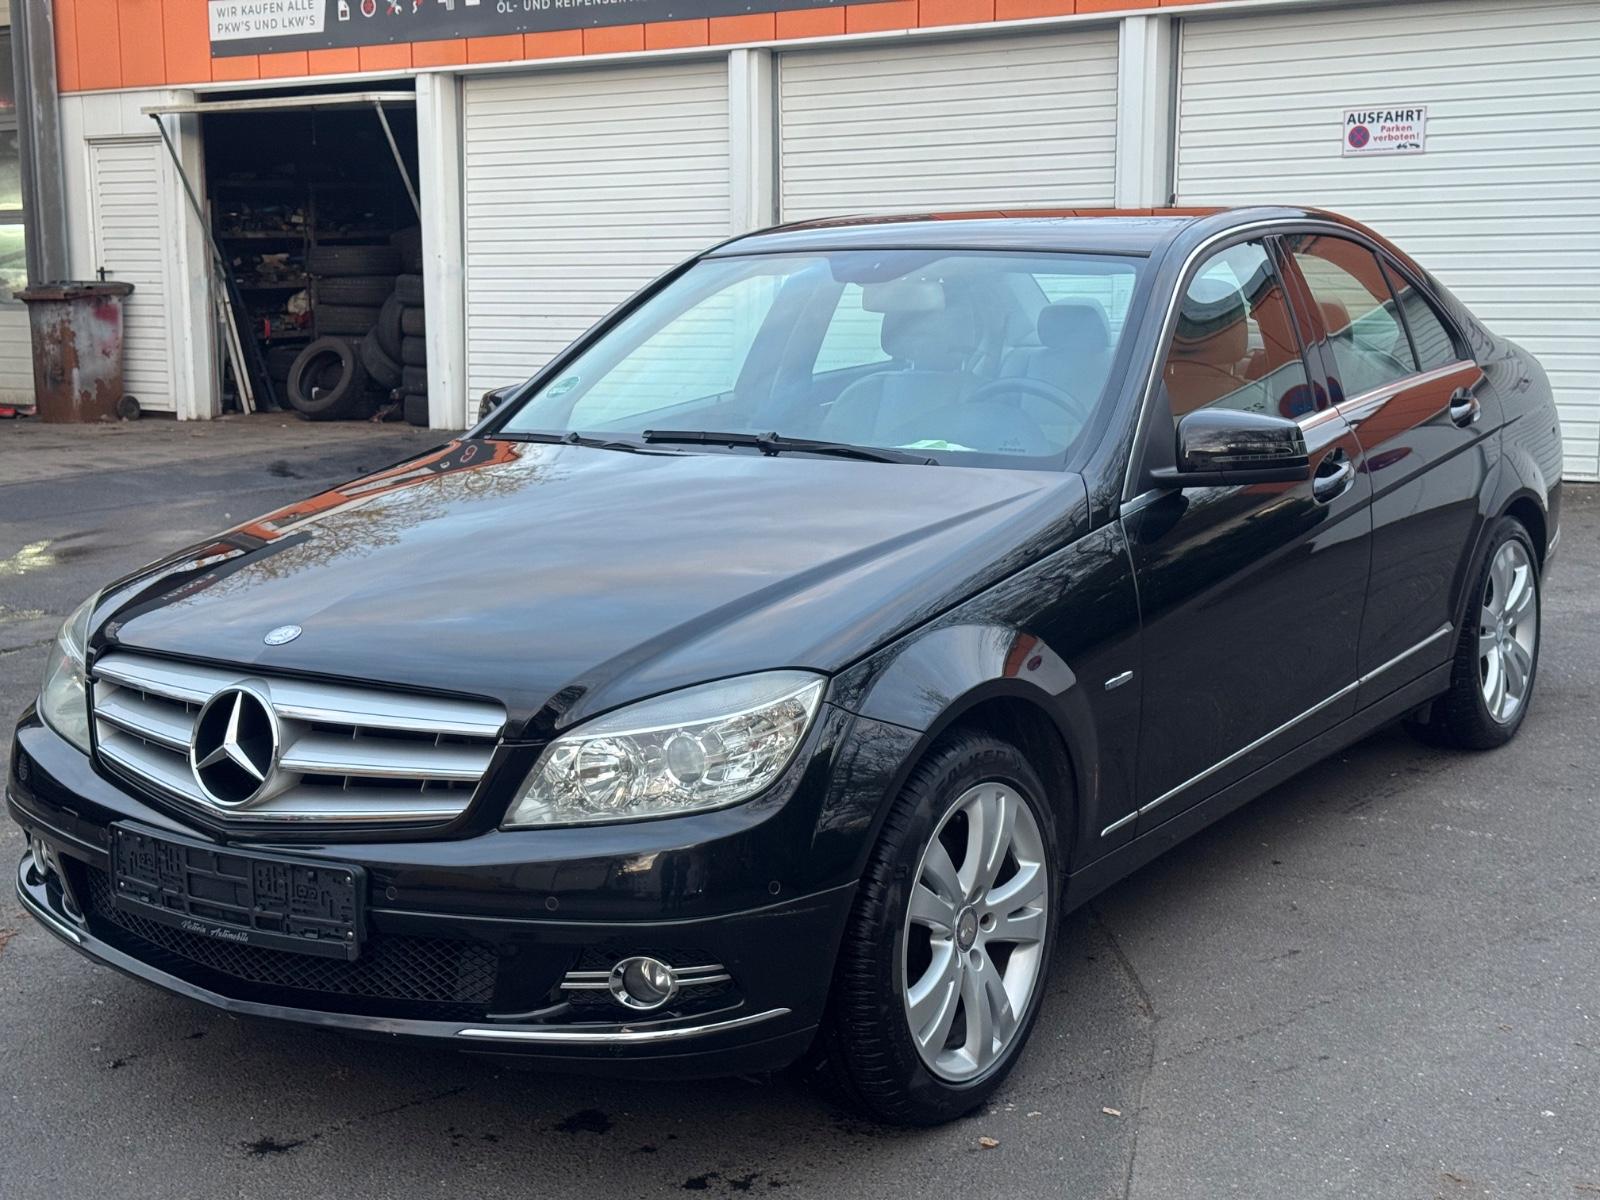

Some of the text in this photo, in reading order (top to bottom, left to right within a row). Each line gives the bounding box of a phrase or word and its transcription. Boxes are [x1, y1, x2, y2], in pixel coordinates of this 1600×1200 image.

[216, 0, 315, 18] WIR KAUFEN ALLE
[523, 0, 550, 11] UND
[217, 15, 316, 33] PKW'S UND LKW'S
[1346, 109, 1423, 125] AUSFAHRT
[1380, 124, 1413, 132] Parken
[1373, 132, 1419, 141] verboten!
